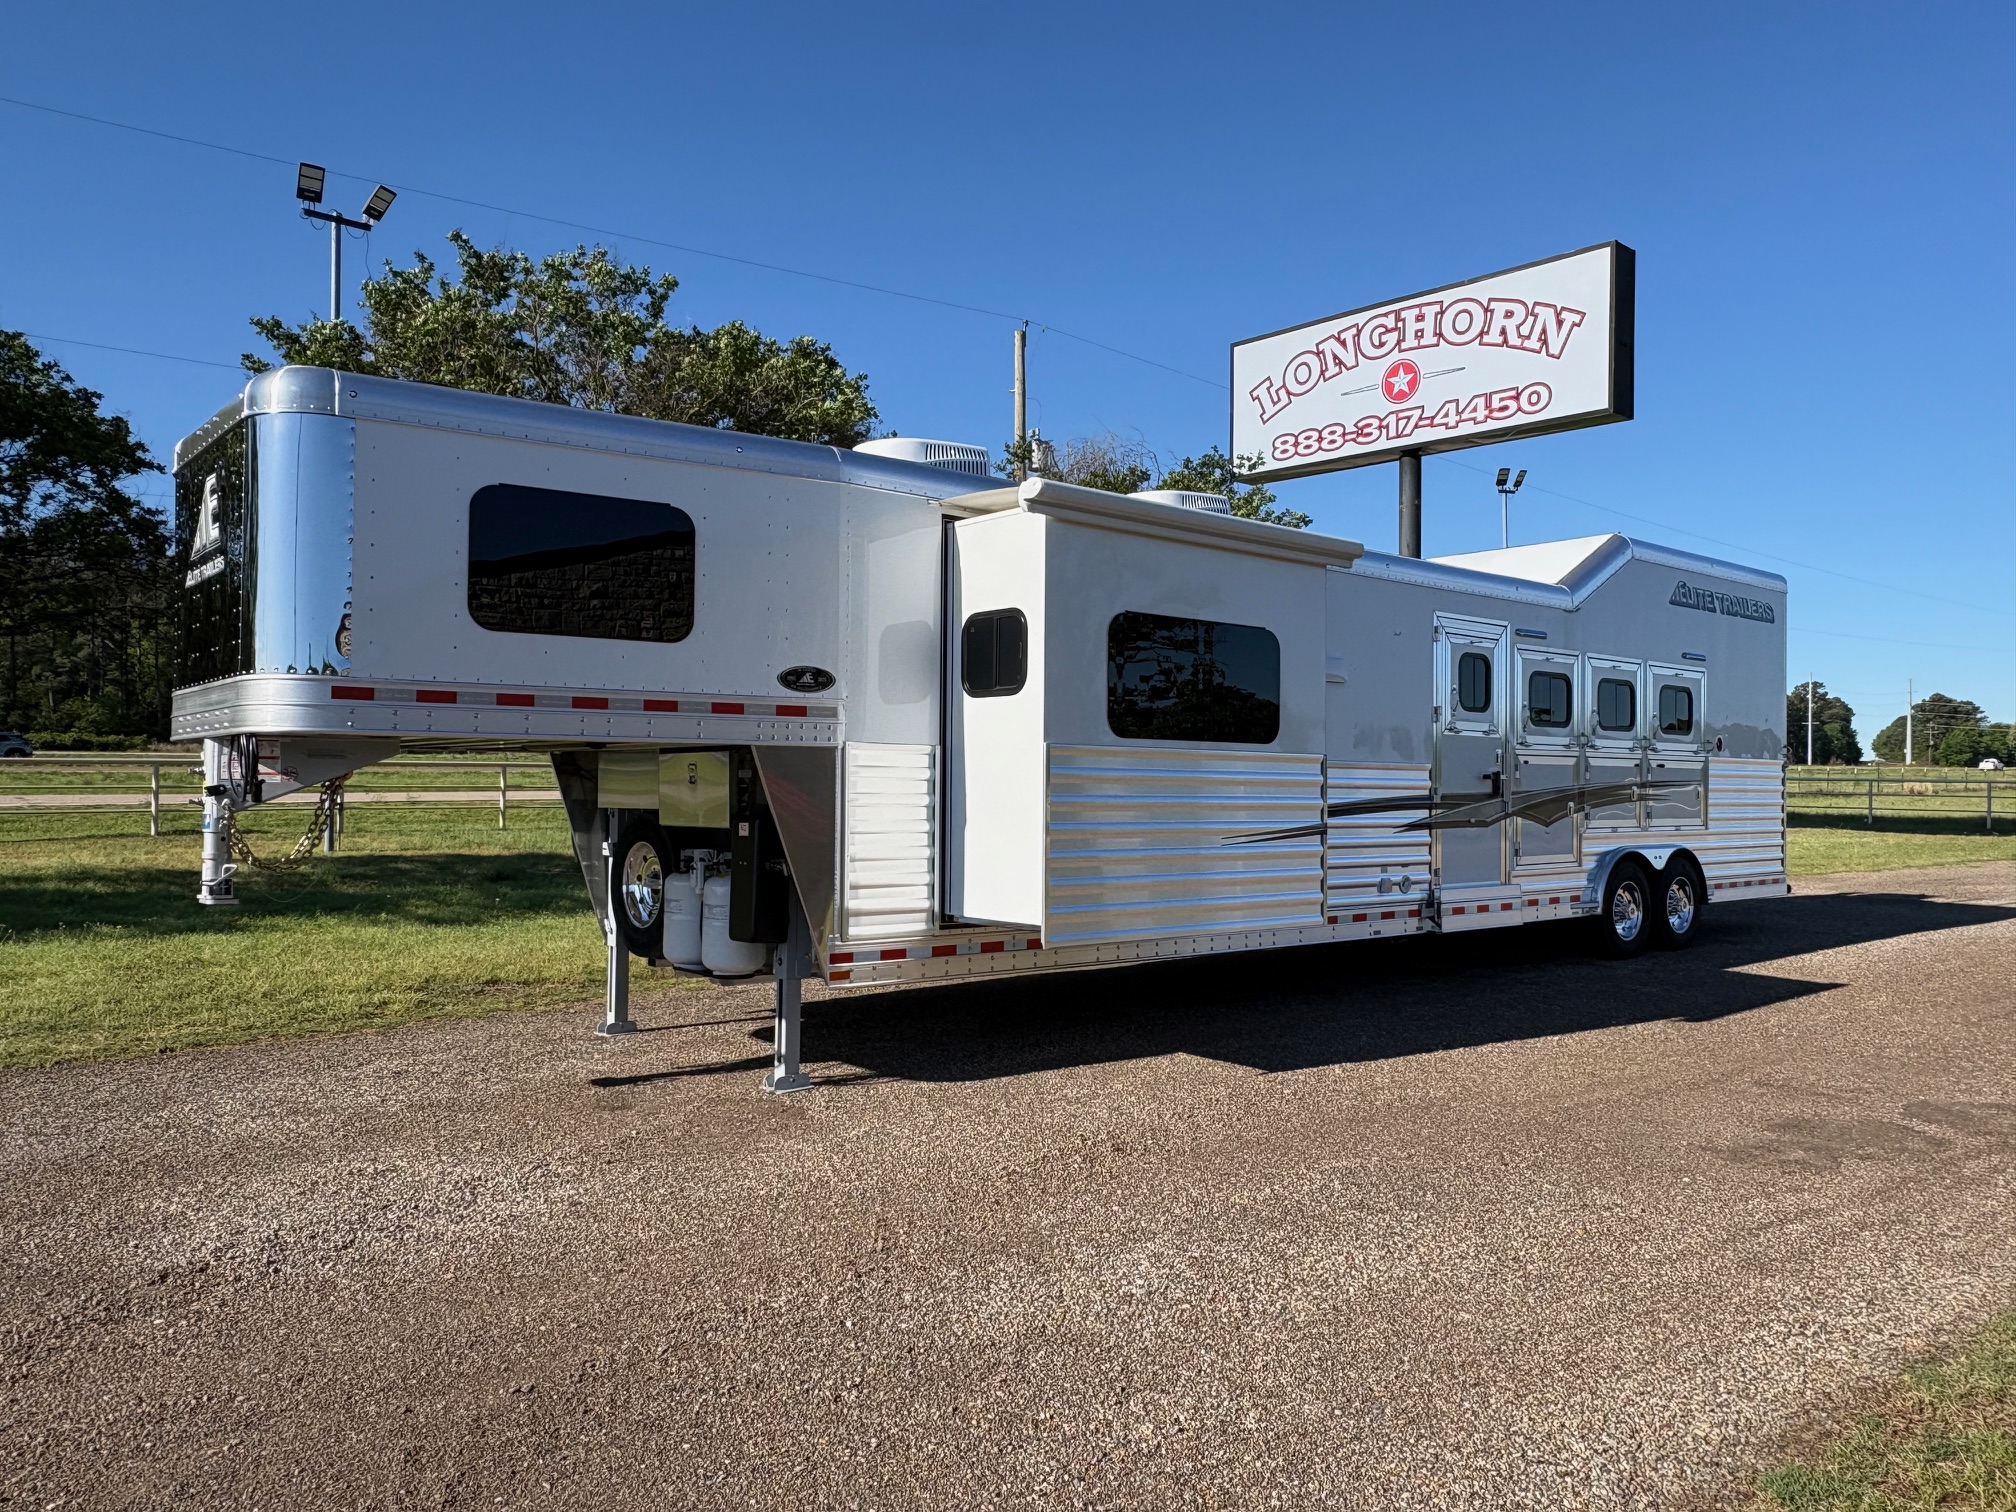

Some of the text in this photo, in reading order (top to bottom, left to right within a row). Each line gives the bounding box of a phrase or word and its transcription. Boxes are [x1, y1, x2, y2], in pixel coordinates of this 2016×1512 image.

[1250, 297, 1586, 425] LONGHORN
[1271, 381, 1552, 461] 888-317-4450
[1669, 581, 1775, 624] ELITE TRAILERS
